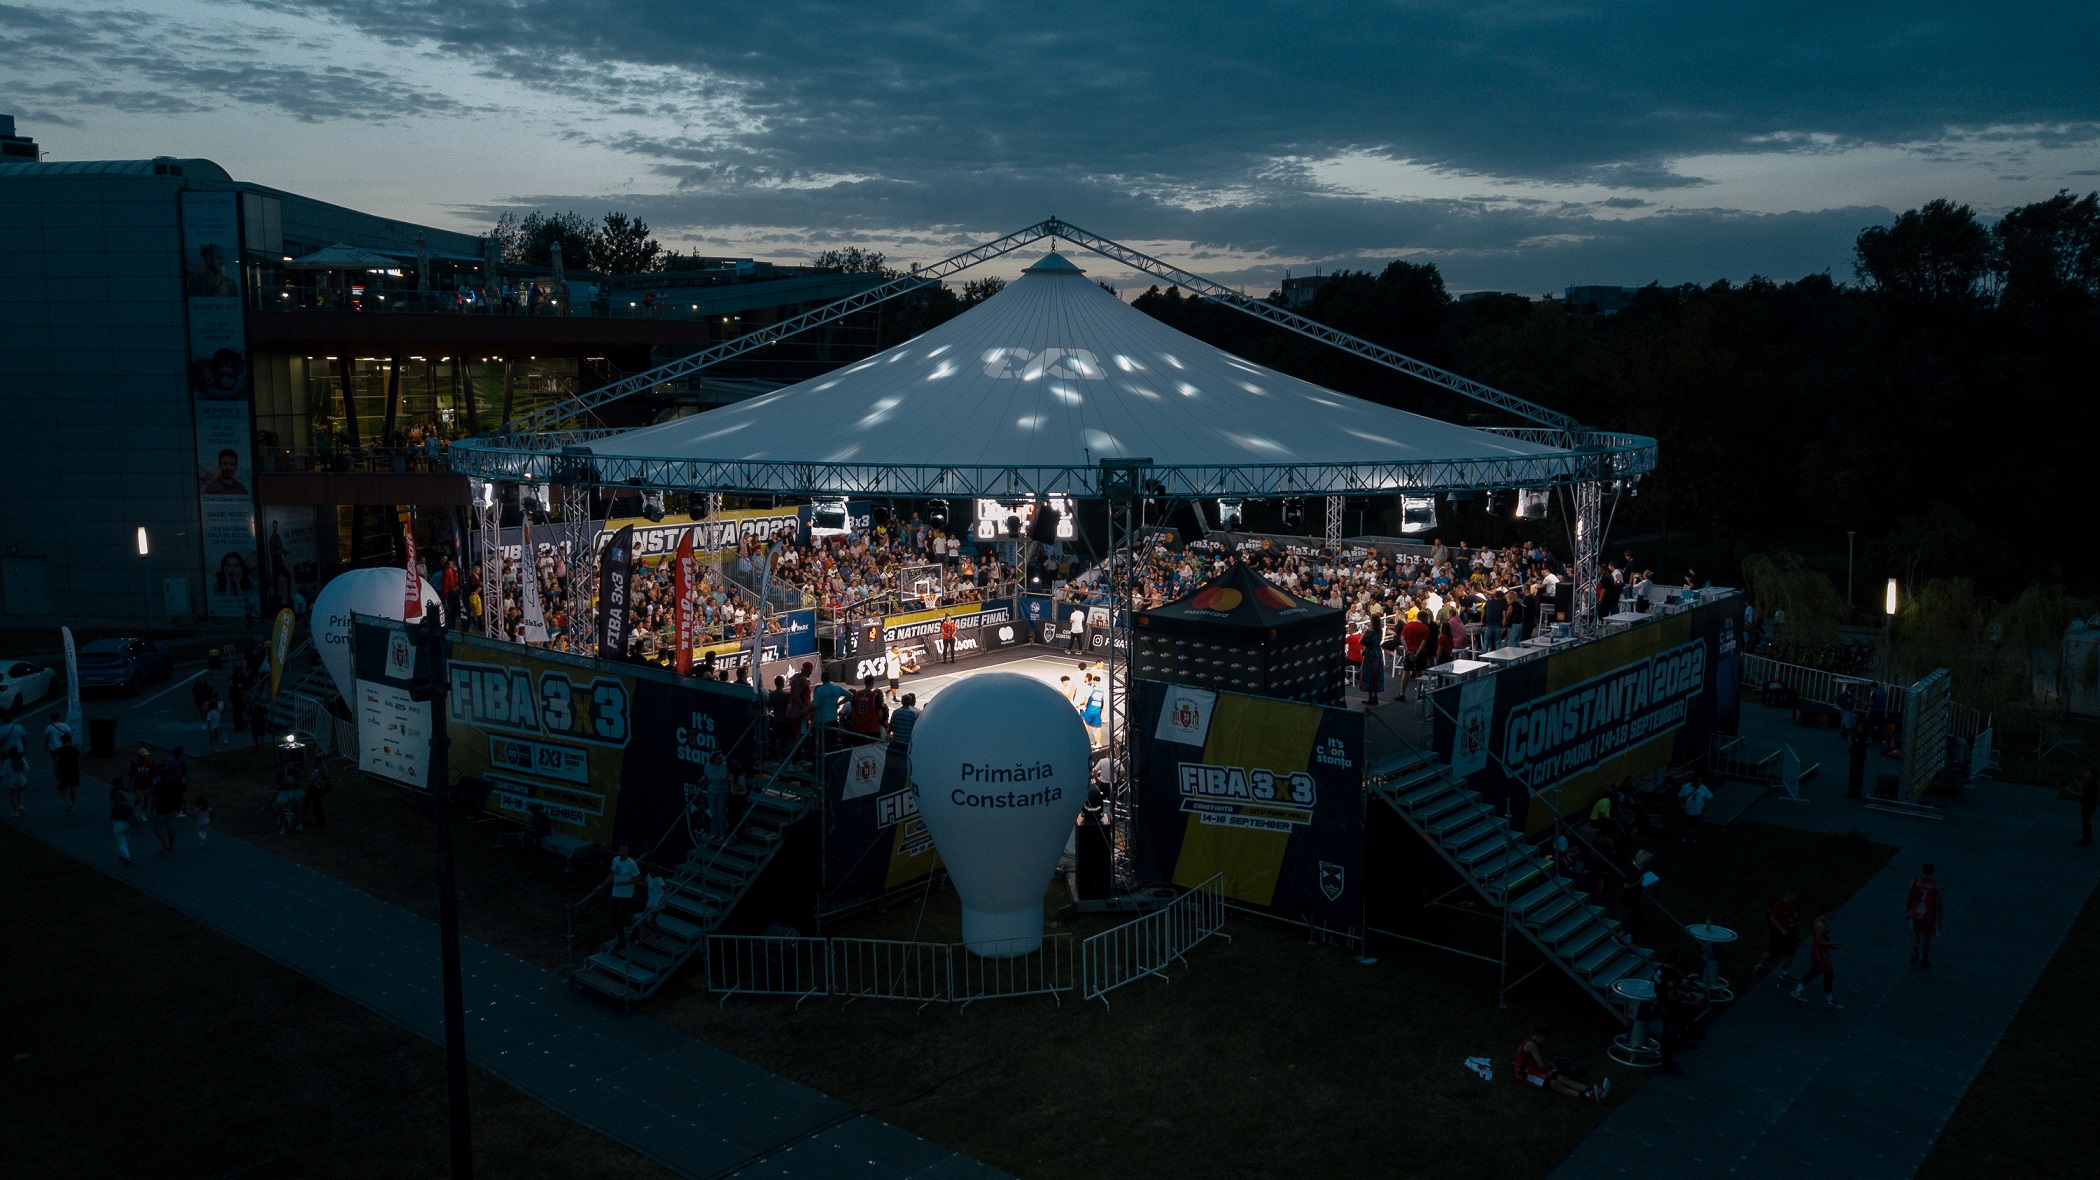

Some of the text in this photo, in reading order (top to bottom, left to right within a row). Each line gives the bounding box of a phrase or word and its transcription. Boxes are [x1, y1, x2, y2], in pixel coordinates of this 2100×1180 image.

[607, 571, 624, 649] FIBA 3x3
[1183, 609, 1229, 618] mastercard
[897, 622, 941, 640] NATIONS
[980, 611, 1007, 626] FINAL
[1651, 647, 1703, 706] 2022
[451, 668, 627, 739] FIBA 3x3
[691, 711, 715, 732] It's
[1327, 737, 1344, 749] It's
[1533, 754, 1562, 786] CITY
[1562, 739, 1593, 770] PARK
[1600, 726, 1628, 754] 14-18
[1630, 699, 1685, 741] SEPTEMBER
[961, 761, 1053, 783] Primăria
[951, 786, 1063, 807] Constanța
[1180, 766, 1314, 804] FIBA 3x3
[502, 796, 523, 809] 14-18
[879, 791, 920, 818] FIB
[1202, 813, 1290, 830] 14-18 SEPTEMBER
